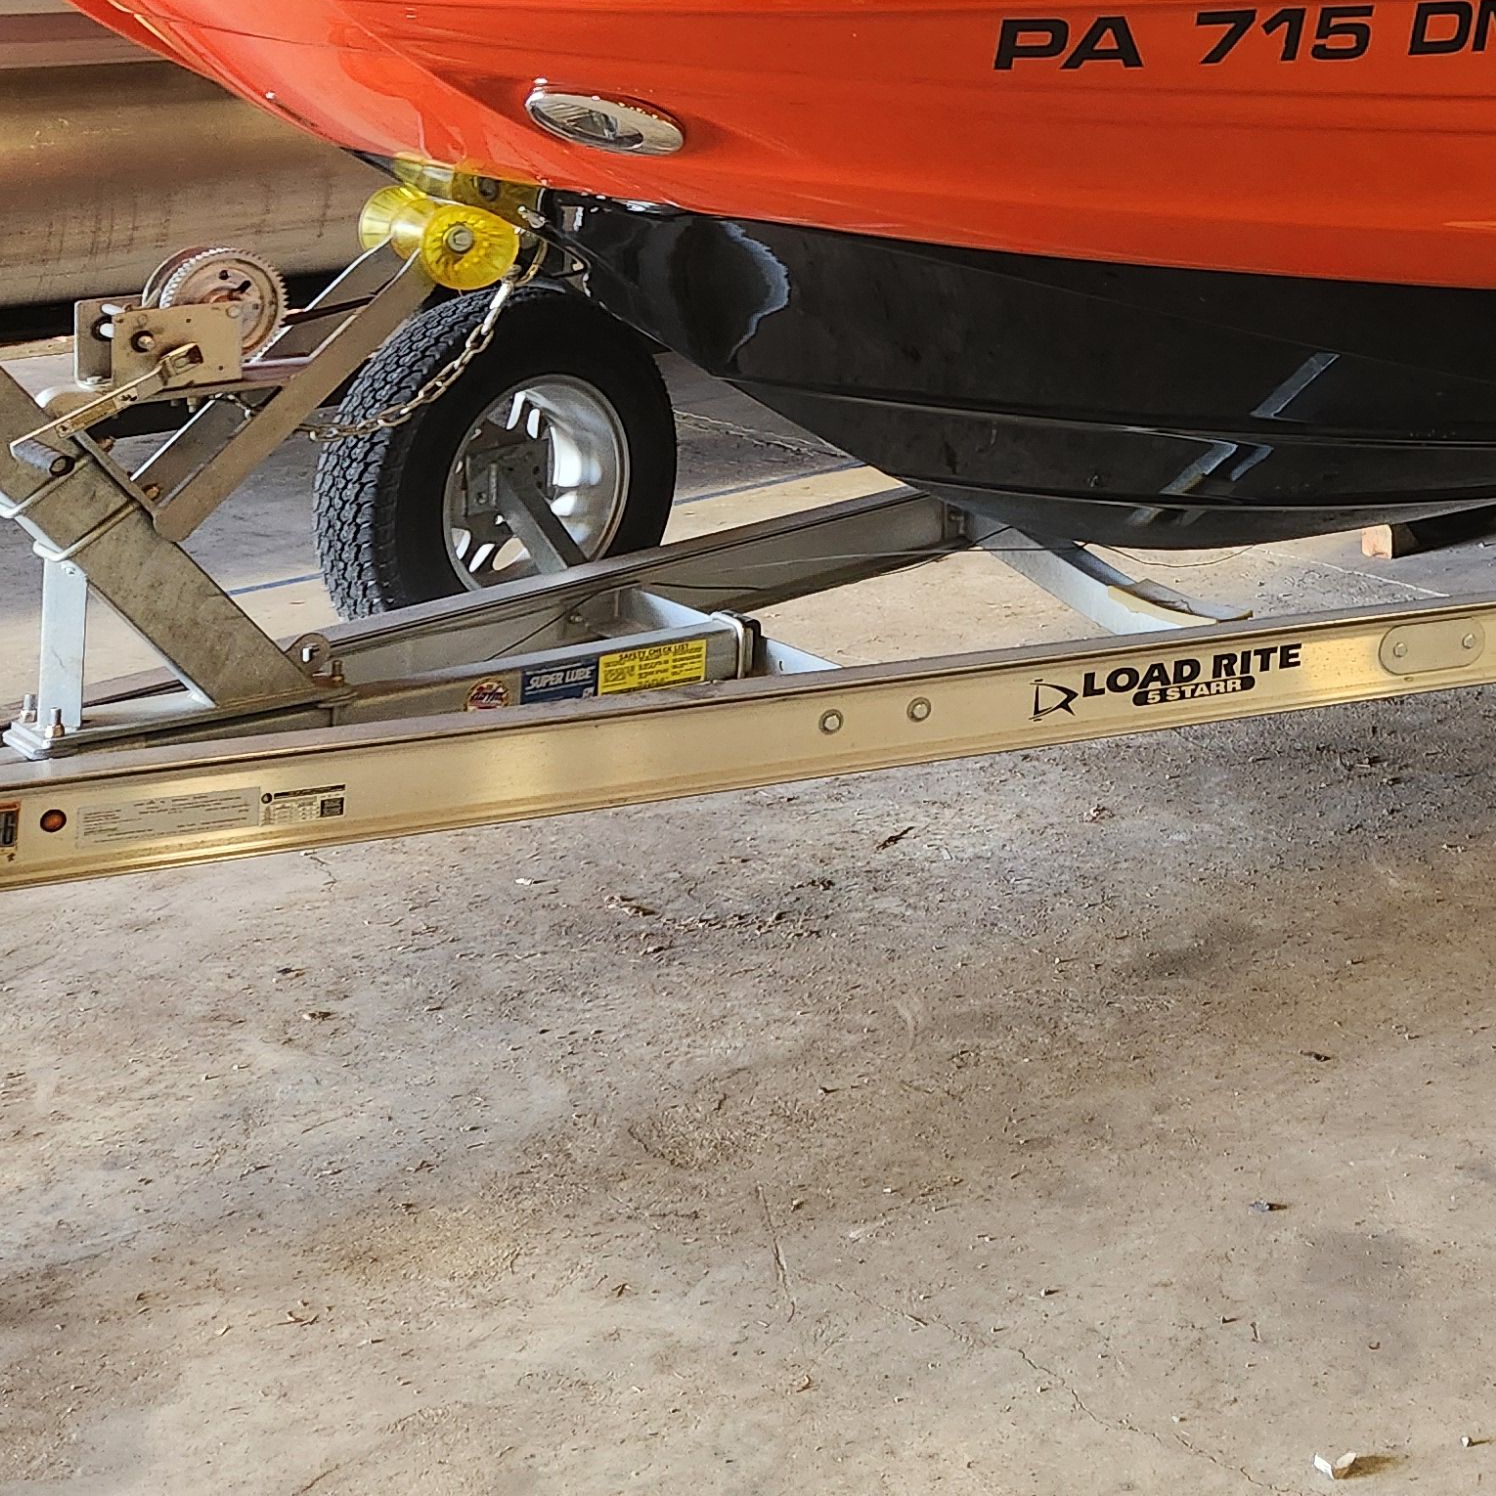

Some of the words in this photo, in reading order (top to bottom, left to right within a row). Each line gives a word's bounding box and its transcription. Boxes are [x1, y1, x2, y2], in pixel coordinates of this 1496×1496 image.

[993, 17, 1143, 70] PA
[1197, 6, 1374, 64] 715
[526, 671, 565, 691] SUPER
[565, 666, 596, 683] LUBE
[1082, 658, 1201, 698] LOAD
[1212, 643, 1302, 679] RITE
[1146, 689, 1160, 704] 5
[1166, 678, 1243, 702] STARR
